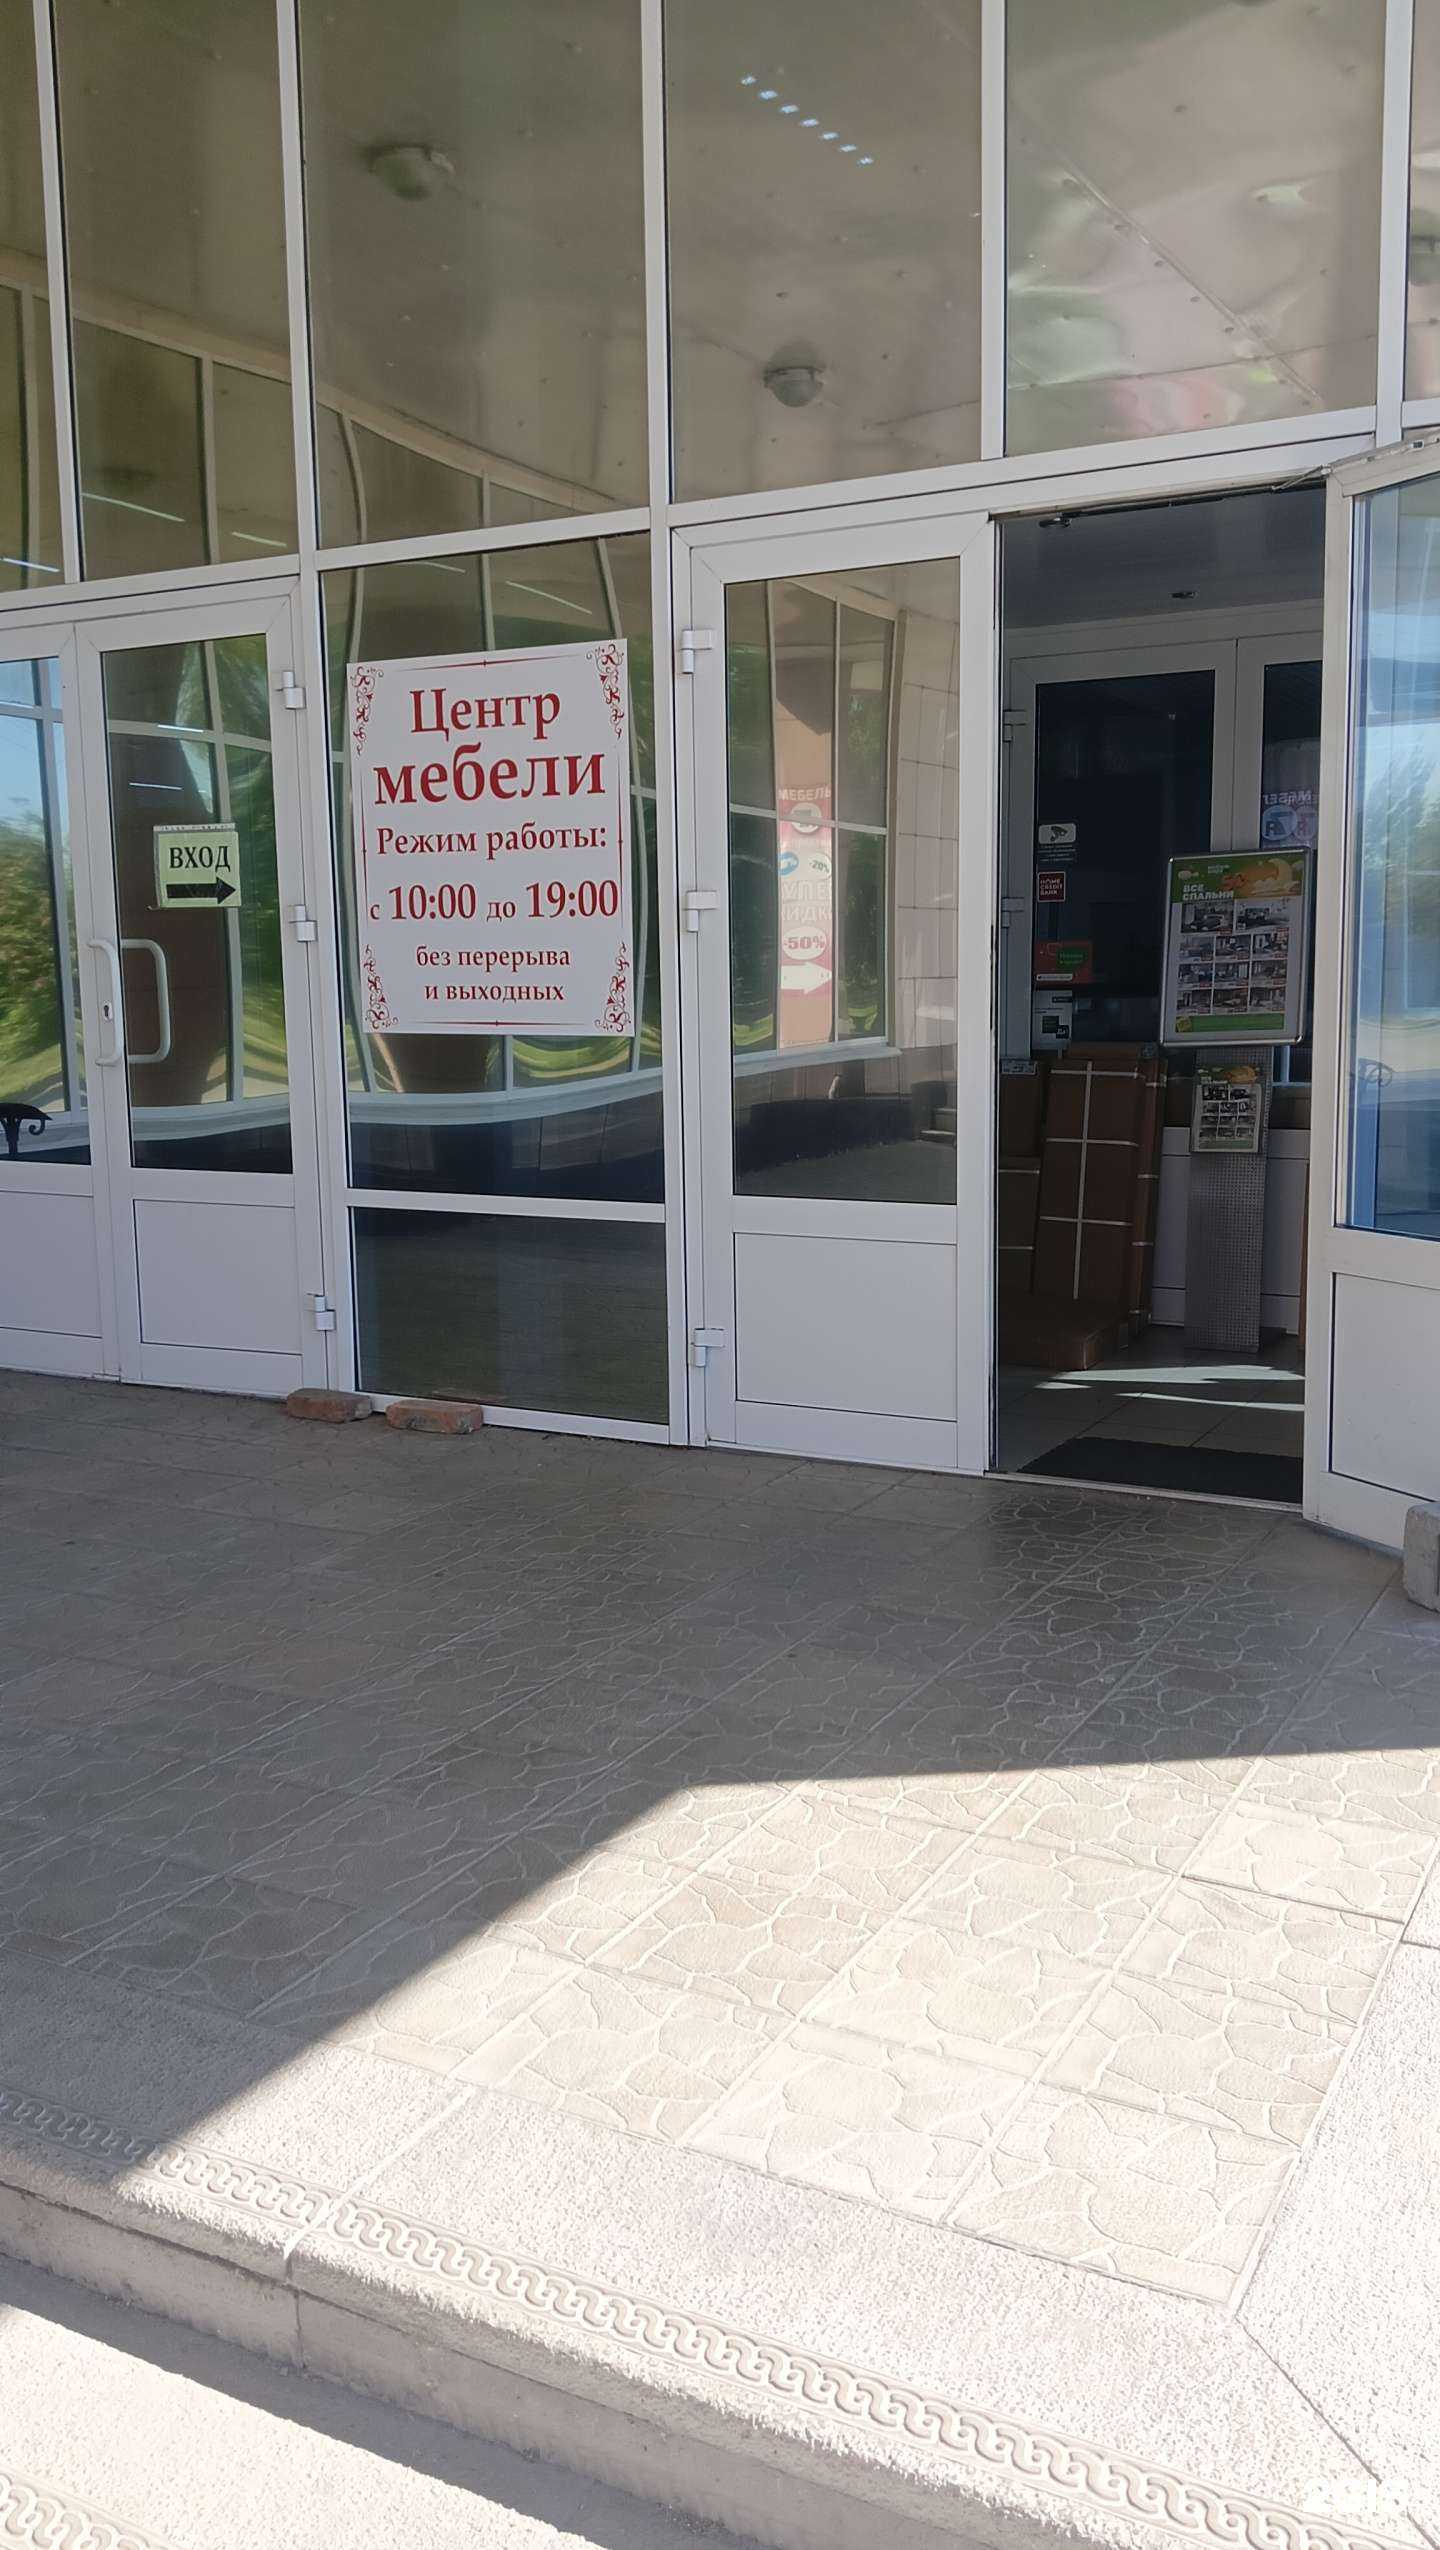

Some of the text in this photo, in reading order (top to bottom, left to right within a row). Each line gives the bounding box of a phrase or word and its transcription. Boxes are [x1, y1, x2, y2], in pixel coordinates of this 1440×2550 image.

[411, 687, 561, 741] Центр
[374, 741, 605, 805] мебели
[377, 822, 607, 860] Режим работы:
[169, 845, 231, 873] ВХОД
[369, 879, 619, 922] с 10:00 до 19:00
[1182, 890, 1235, 901] СПАЛЬНИ
[783, 935, 825, 950] -50%
[415, 945, 571, 972] без перерыва
[424, 985, 565, 1003] и выходных
